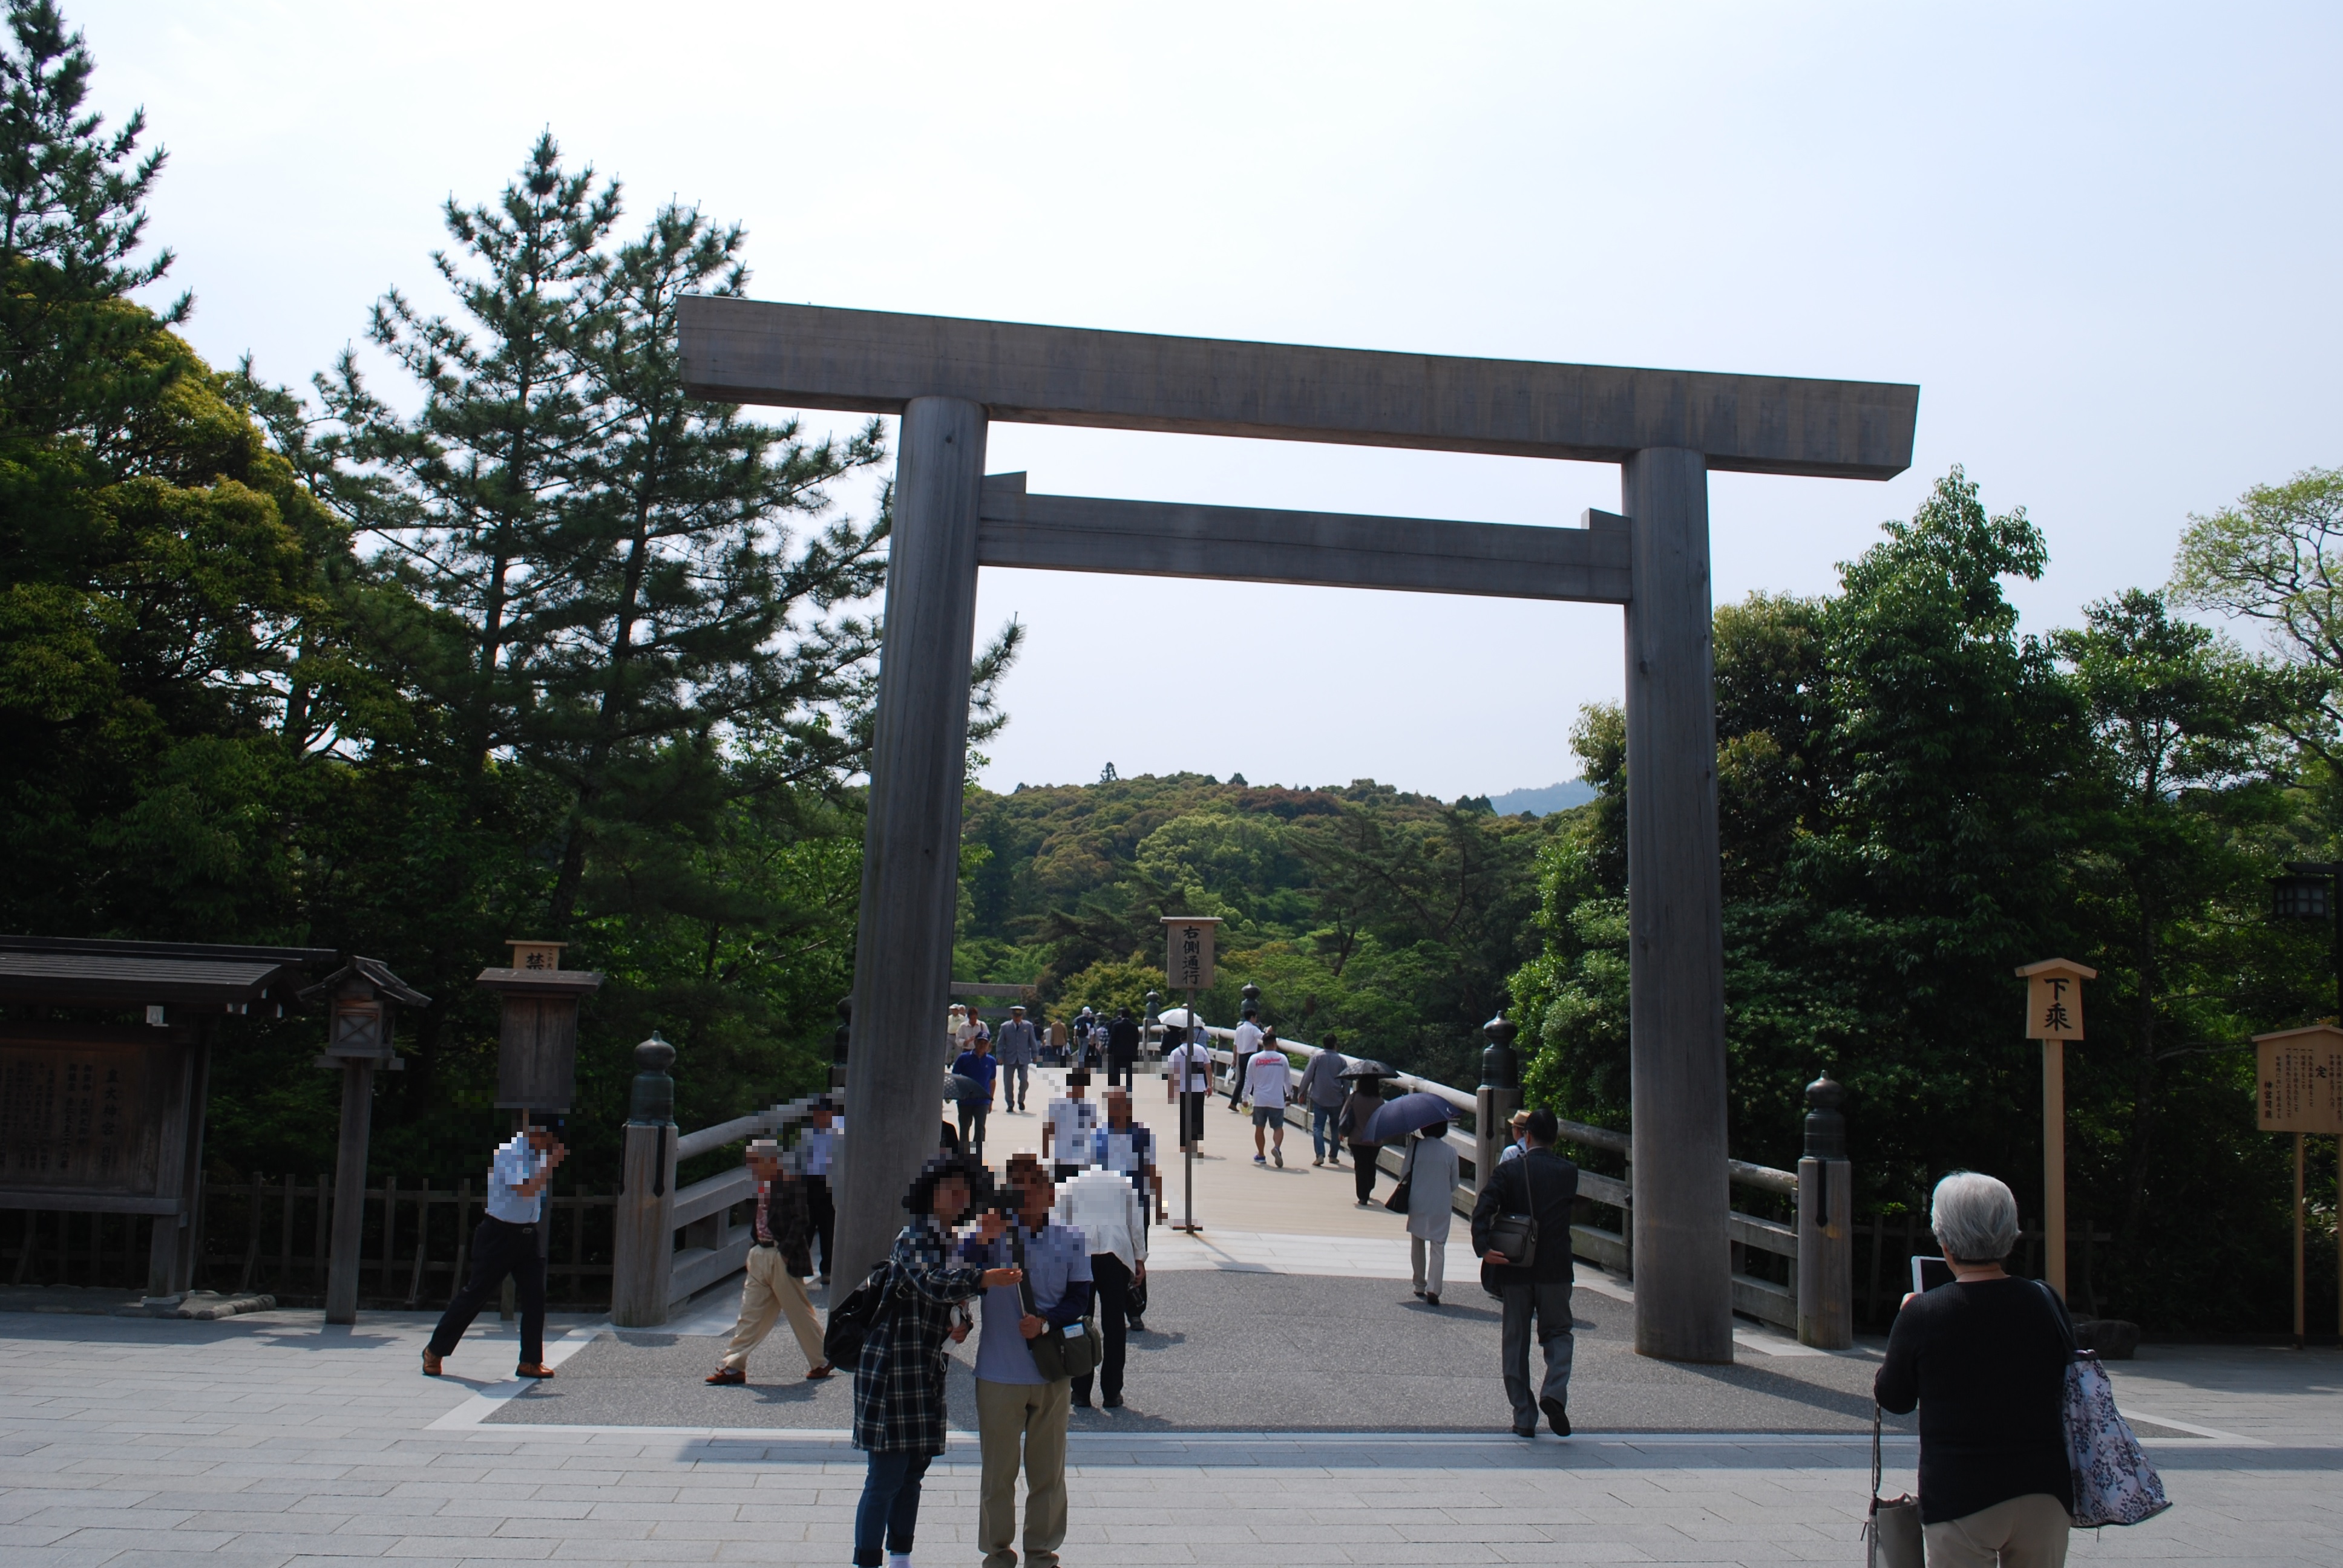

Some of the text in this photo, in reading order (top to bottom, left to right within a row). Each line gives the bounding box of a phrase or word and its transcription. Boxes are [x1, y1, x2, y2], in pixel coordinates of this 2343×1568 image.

[526, 952, 544, 969] 禁
[1182, 926, 1201, 984] 右側通行
[2315, 1065, 2327, 1078] 定
[102, 1068, 119, 1135] 皇大神宮
